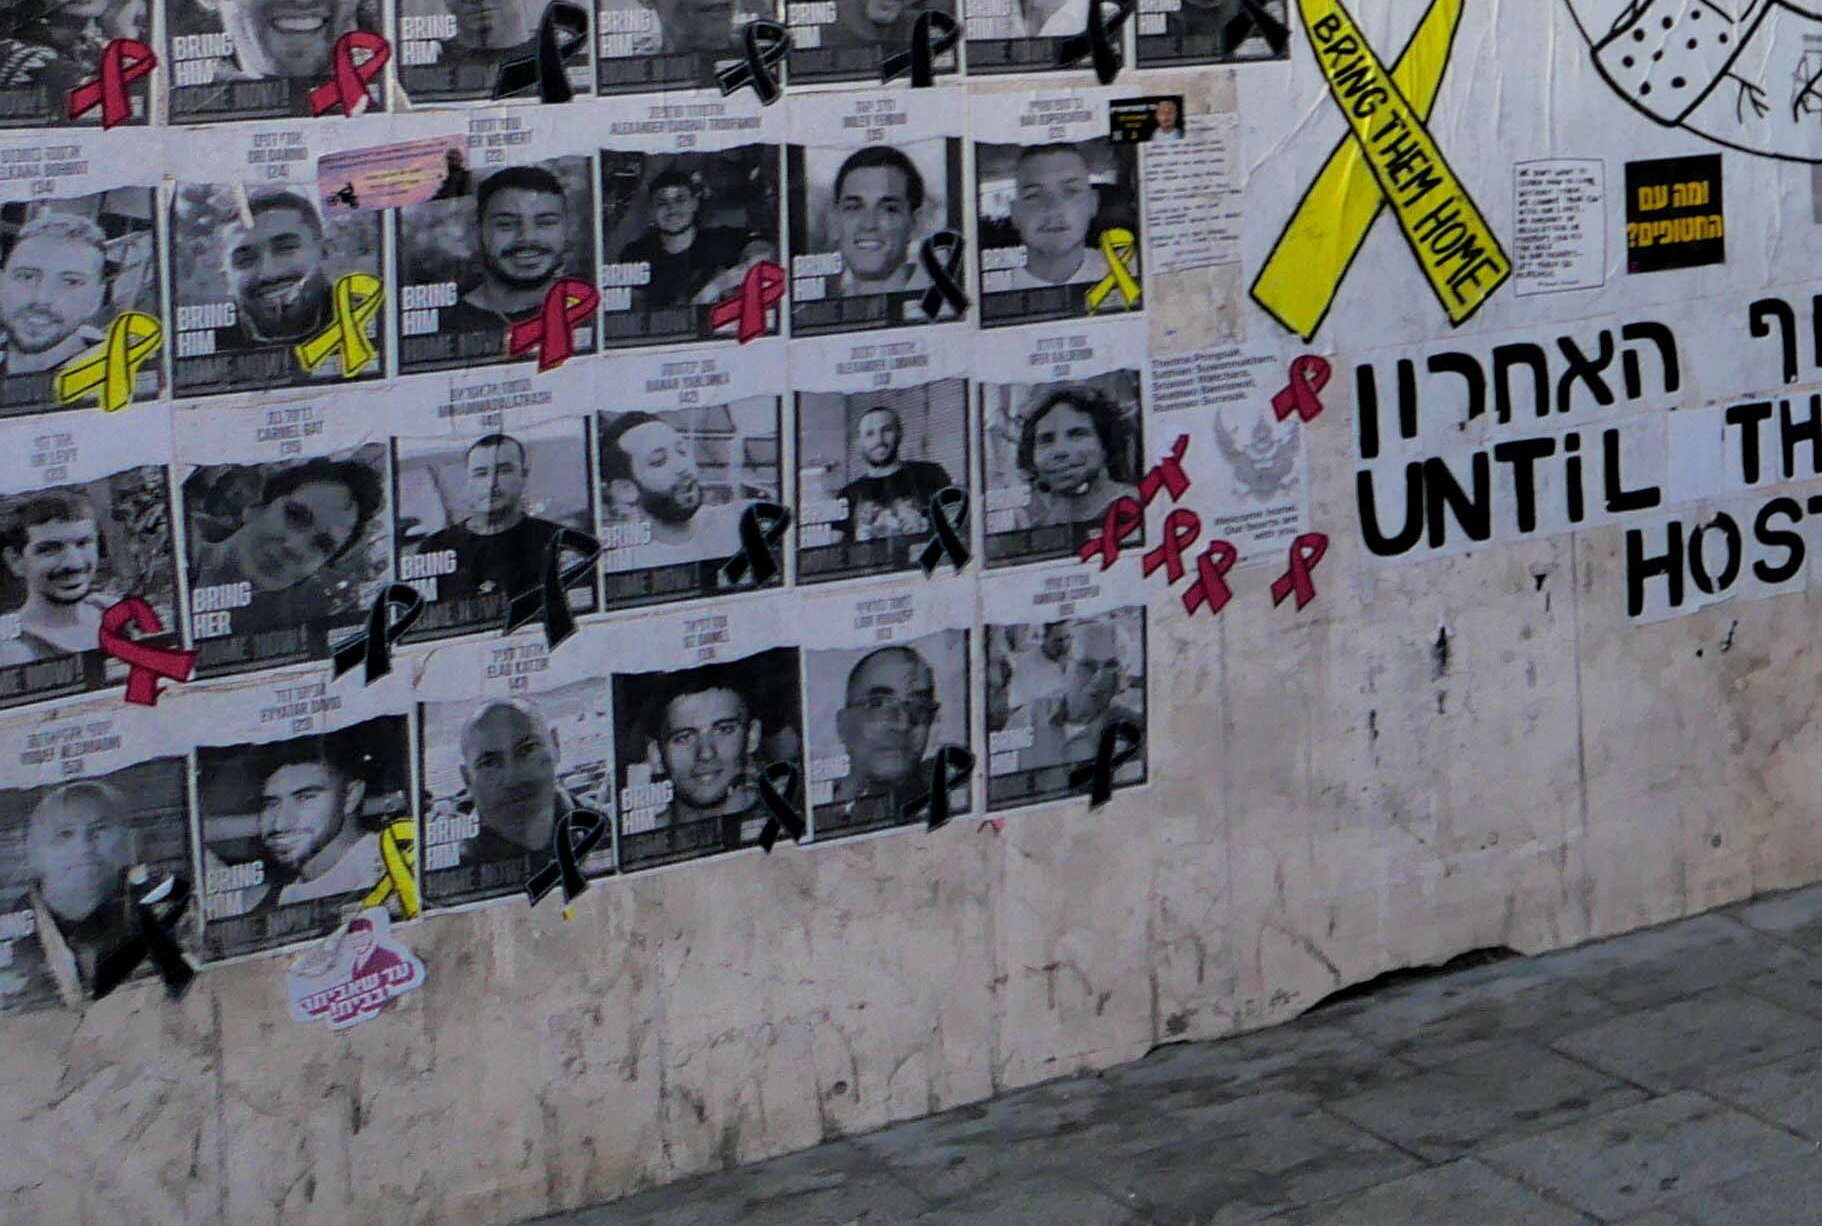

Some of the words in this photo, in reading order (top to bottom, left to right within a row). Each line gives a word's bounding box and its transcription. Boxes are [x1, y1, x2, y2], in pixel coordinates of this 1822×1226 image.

[401, 14, 457, 41] BRING
[173, 33, 234, 59] BRING
[1313, 13, 1389, 120] BRING
[1372, 108, 1440, 210] THEM
[1412, 196, 1500, 308] HOME
[1638, 184, 1668, 211] עם
[1672, 180, 1710, 207] ומה
[1627, 214, 1724, 248] החטופים?
[402, 282, 458, 311] BRING
[176, 302, 237, 332] BRING
[1355, 320, 1680, 460] האחרון
[400, 550, 457, 579] BRING
[194, 582, 252, 613] BRING
